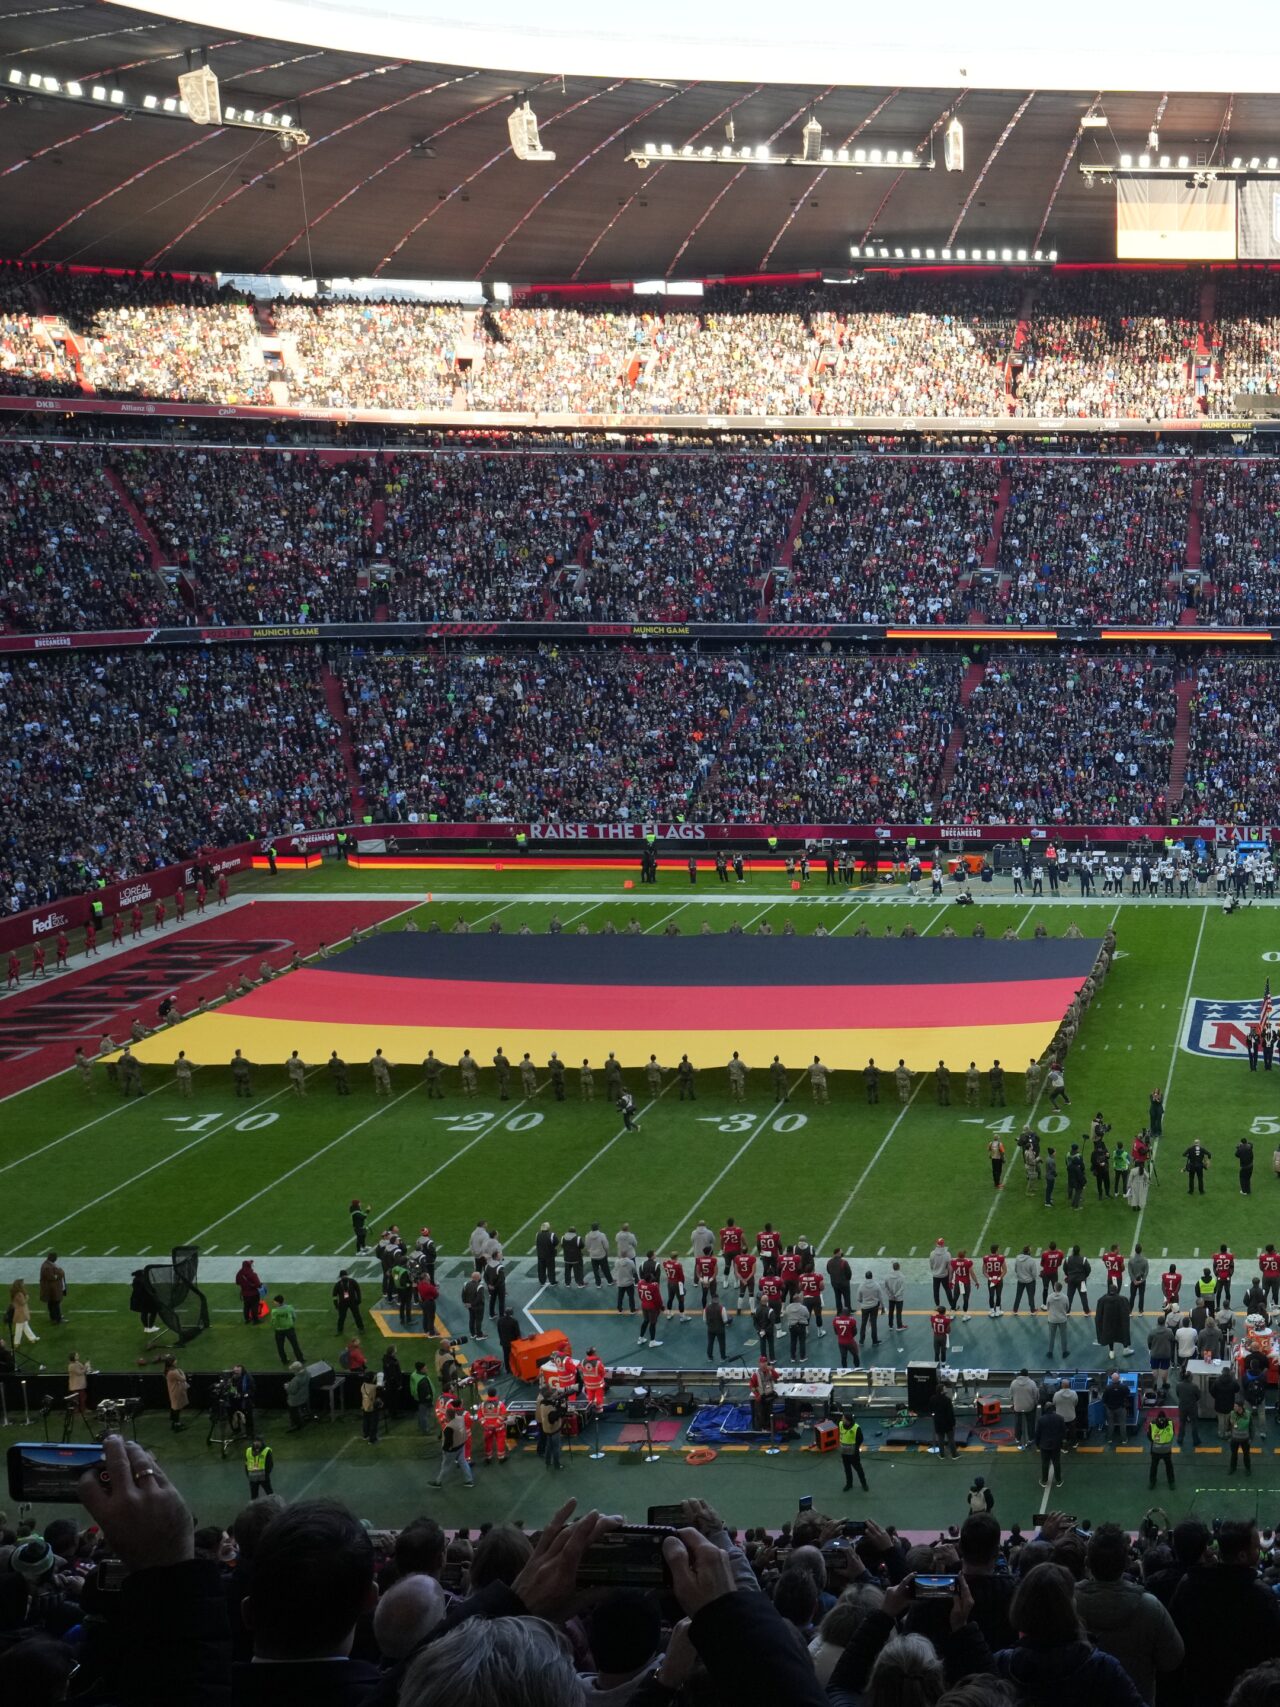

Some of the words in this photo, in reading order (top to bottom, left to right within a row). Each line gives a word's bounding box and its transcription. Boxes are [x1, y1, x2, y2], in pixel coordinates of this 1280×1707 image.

[36, 401, 54, 409] DKB
[121, 404, 145, 412] Allianz
[253, 629, 290, 637] MUNICH
[292, 628, 319, 636] GAME
[633, 626, 665, 634] MUNICH
[666, 626, 690, 634] GAME
[35, 638, 71, 648] BUCCANEERS
[530, 823, 588, 839] RAISE
[593, 823, 635, 839] THE
[642, 823, 705, 839] FLAGS
[940, 829, 981, 838] BUCCANEERS
[221, 858, 241, 870] Bayern
[119, 897, 132, 907] MEN
[132, 890, 152, 903] EXPERT
[32, 912, 65, 935] FedEx
[175, 1112, 280, 1132] 10
[445, 1112, 545, 1132] 20
[718, 1113, 808, 1133] 30
[984, 1114, 1071, 1134] 40
[724, 1235, 738, 1243] 72
[761, 1239, 774, 1248] 60
[702, 1264, 709, 1273] 5
[741, 1262, 747, 1271] 3
[781, 1262, 795, 1271] 73
[987, 1262, 1000, 1272] 88
[1216, 1260, 1230, 1270] 22
[1263, 1262, 1277, 1270] 78
[956, 1267, 965, 1276] 41
[802, 1282, 816, 1291] 75
[1169, 1280, 1172, 1290] 1
[640, 1290, 652, 1300] 76
[763, 1286, 777, 1295] 69
[840, 1326, 846, 1335] 7
[934, 1324, 944, 1333] 10
[1261, 1339, 1269, 1347] G
